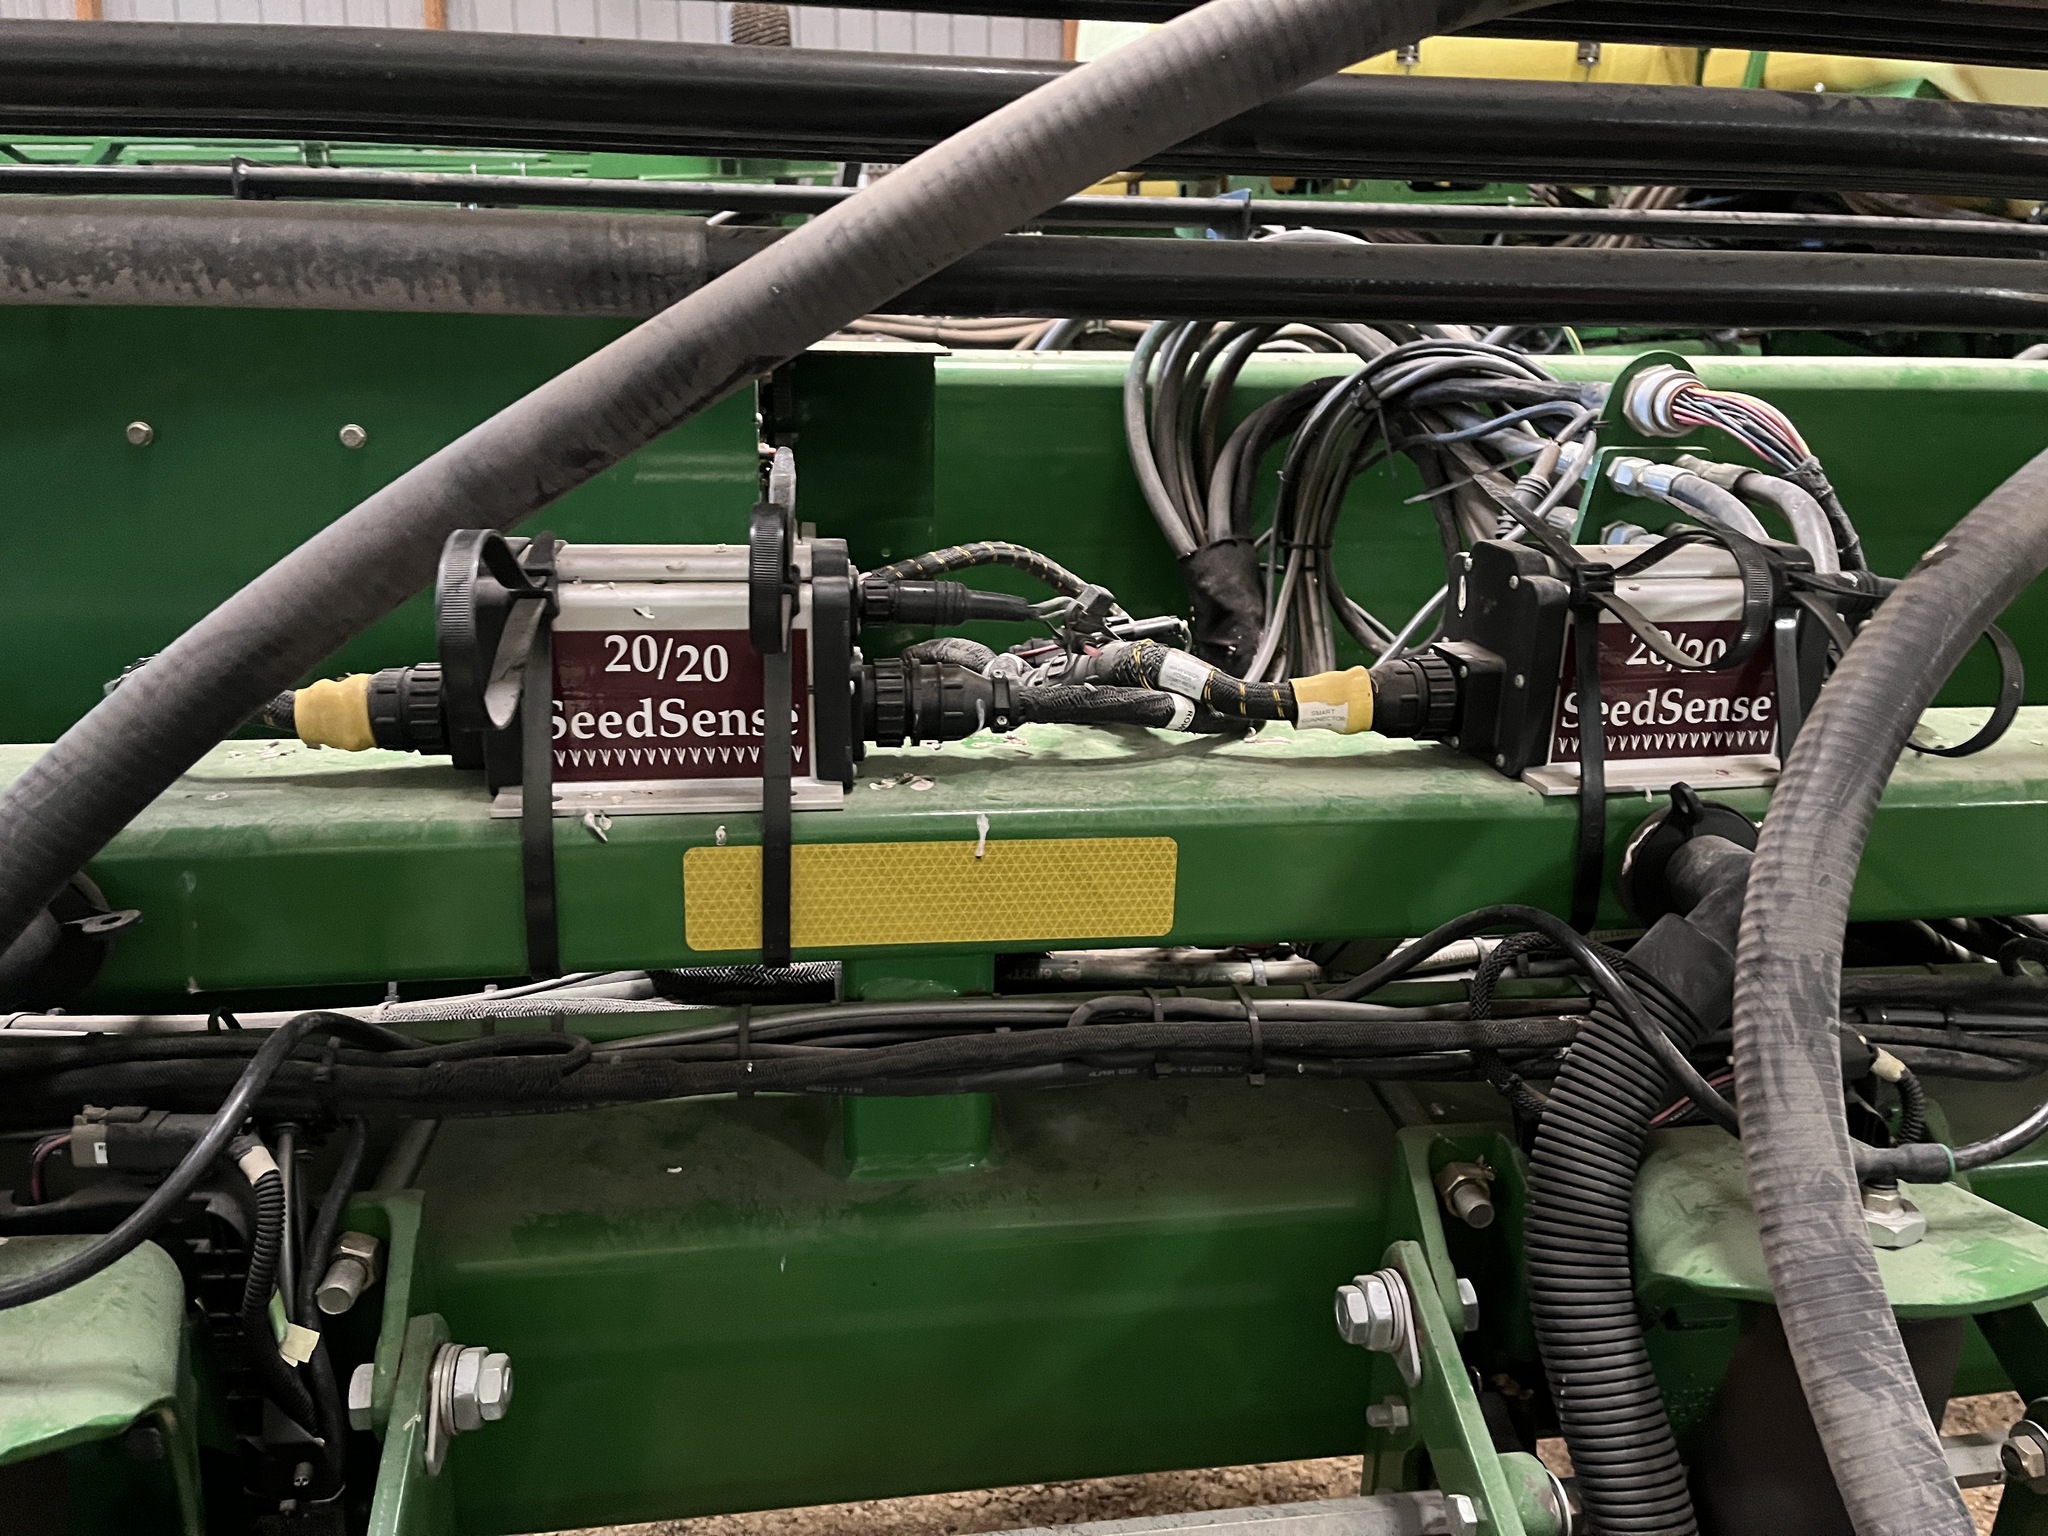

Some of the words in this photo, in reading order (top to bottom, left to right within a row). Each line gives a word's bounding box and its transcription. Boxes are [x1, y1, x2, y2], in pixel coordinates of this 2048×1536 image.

[604, 634, 729, 683] 20/20
[1624, 629, 1727, 674] 20/20
[1311, 709, 1335, 717] SMART
[1561, 688, 1772, 728] SedSense
